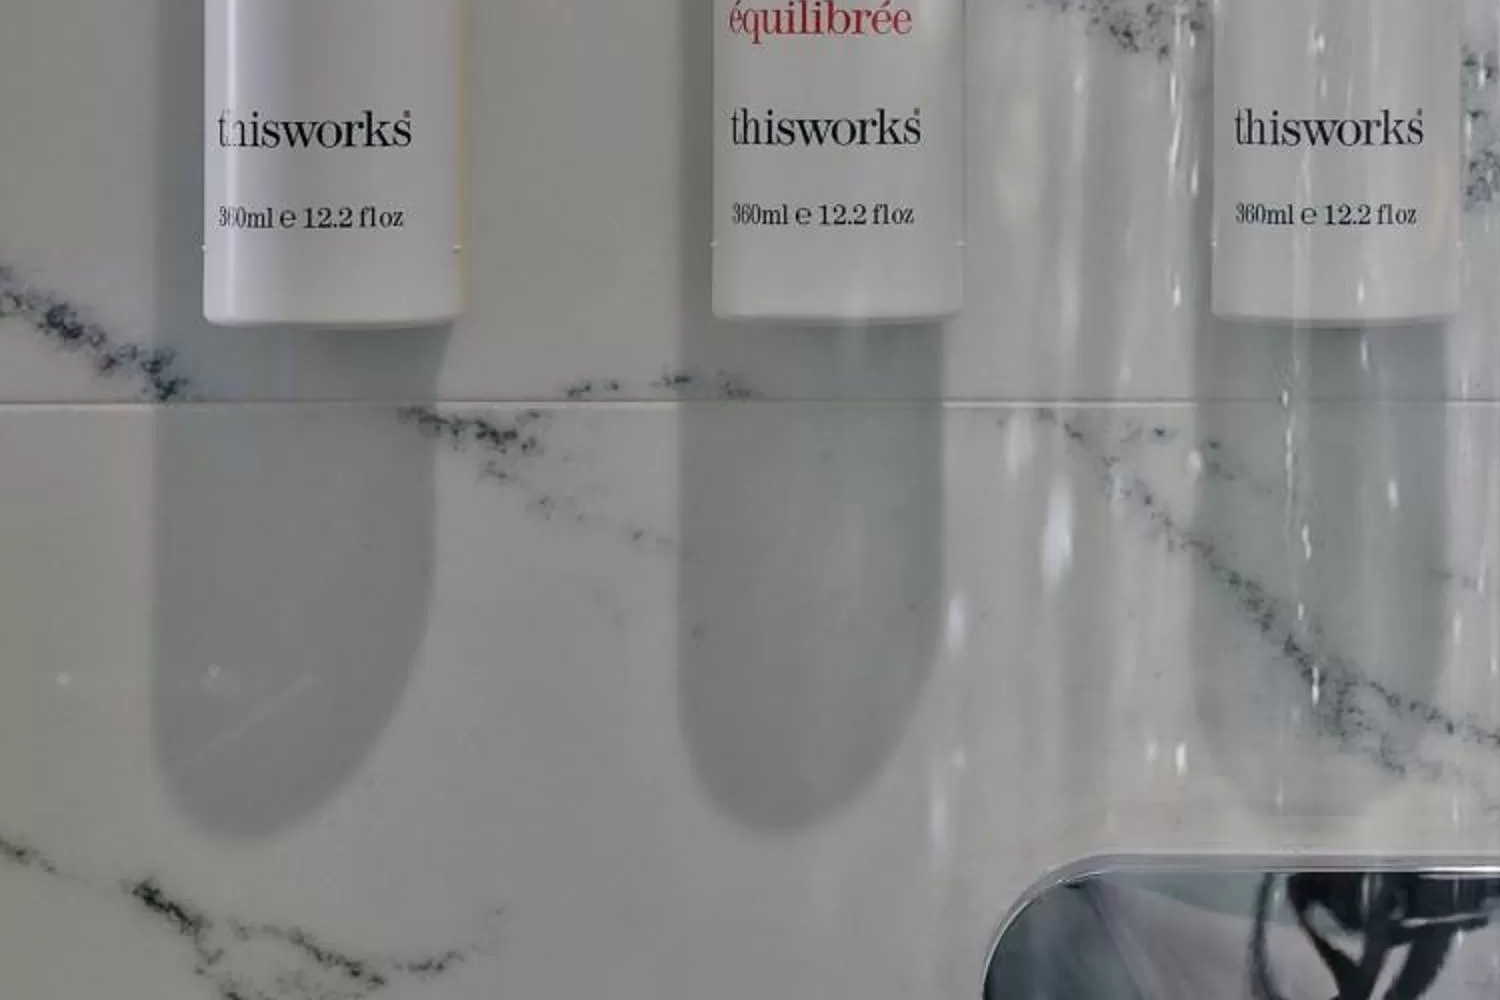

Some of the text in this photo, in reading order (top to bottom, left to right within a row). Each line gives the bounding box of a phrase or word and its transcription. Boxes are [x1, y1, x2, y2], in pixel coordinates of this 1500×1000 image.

[729, 0, 913, 44] équilibrée
[303, 206, 353, 229] 12.2
[732, 203, 788, 225] 360ml
[818, 204, 867, 225] 12.2
[1235, 203, 1294, 225] 360ml
[1325, 204, 1371, 225] 12.2
